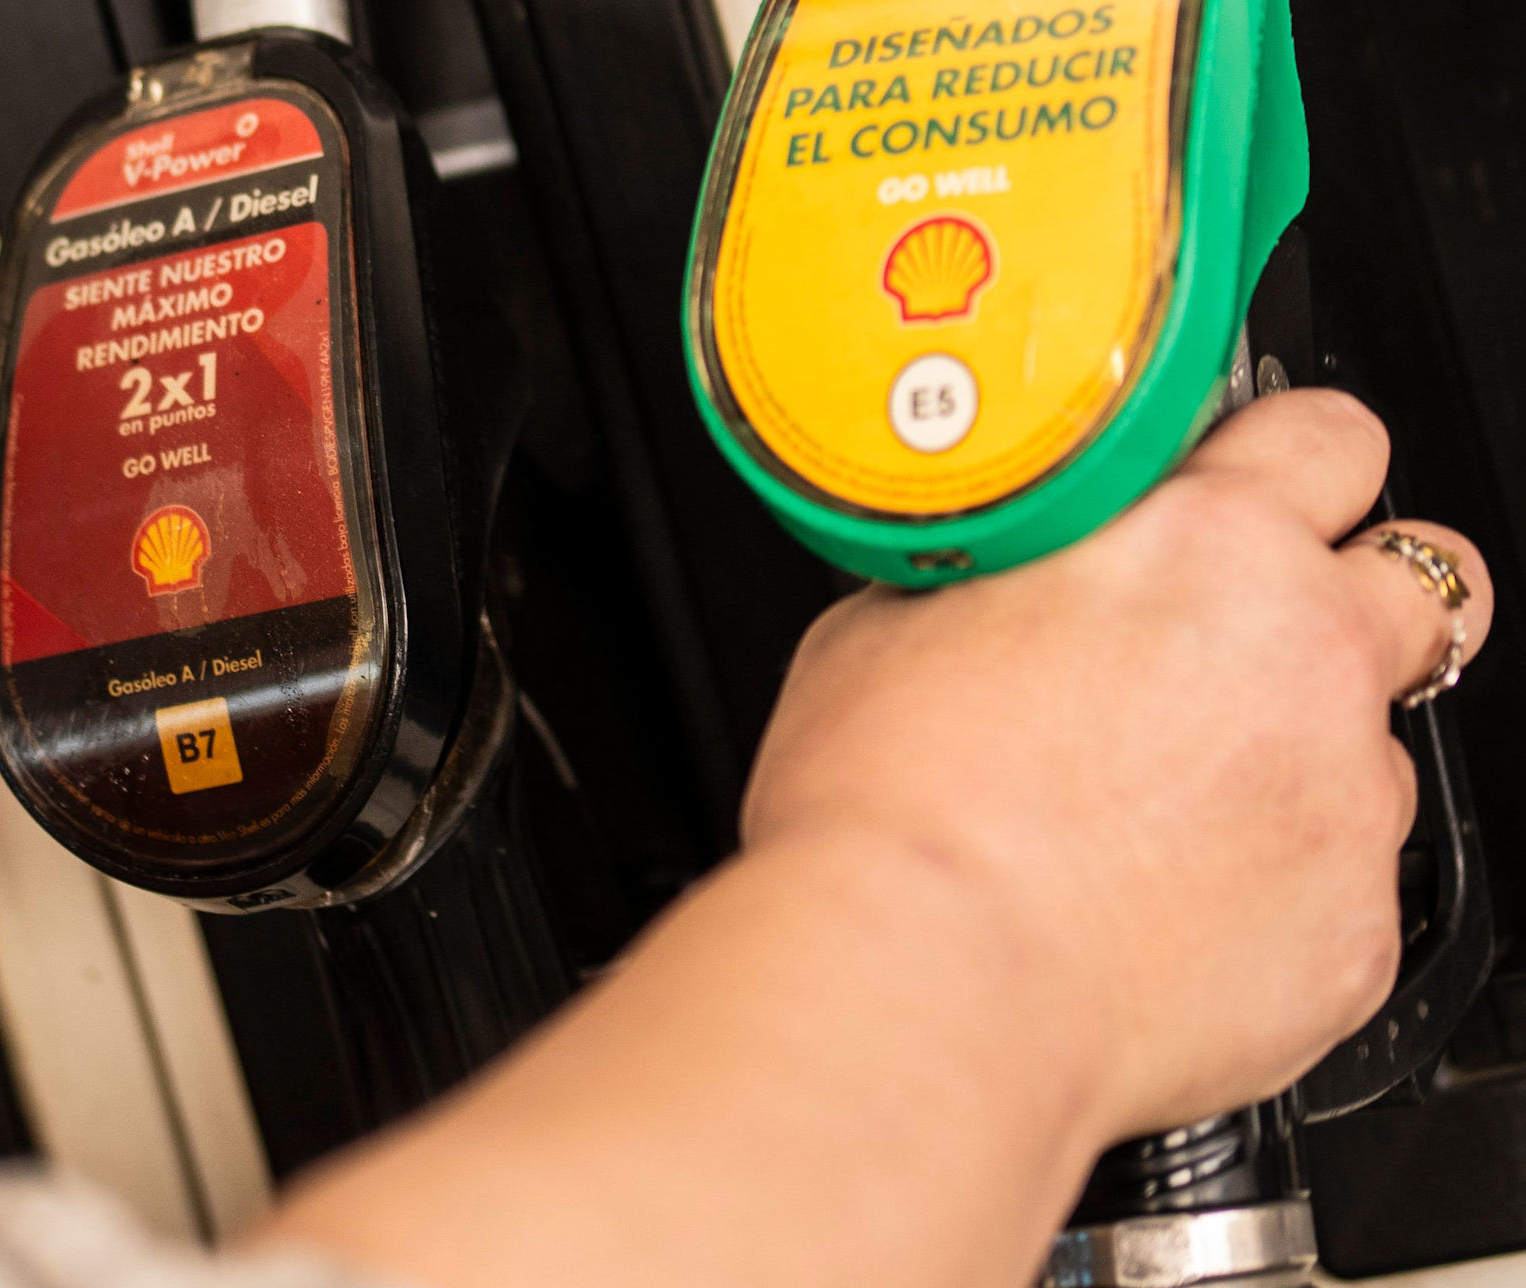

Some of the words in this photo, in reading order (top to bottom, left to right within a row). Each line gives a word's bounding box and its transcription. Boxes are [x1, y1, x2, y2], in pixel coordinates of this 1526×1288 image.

[828, 5, 1116, 69] DISEÑADOS
[784, 76, 911, 119] PARA
[931, 46, 1137, 101] REDUCIR
[127, 133, 174, 159] Shell
[786, 134, 830, 167] EL
[851, 96, 1117, 160] CONSUMO
[124, 142, 247, 186] V-Power
[878, 175, 928, 206] GO
[936, 165, 1010, 198] WELL
[46, 218, 165, 268] Gasóleo
[173, 207, 196, 237] A
[230, 174, 318, 222] Diesel
[64, 270, 152, 311] SIENTE
[160, 238, 286, 290] NUESTRO
[110, 283, 233, 331] MÁXIMO
[76, 308, 264, 371] RENDIMIENTO
[120, 352, 217, 420] 2x1
[911, 386, 956, 421] E5
[119, 418, 143, 437] en
[150, 402, 216, 434] puntos
[123, 455, 156, 479] GO
[160, 443, 212, 472] WELL
[108, 669, 177, 698] Gasóleo
[181, 664, 196, 682] A
[213, 649, 263, 677] Diesel
[176, 729, 216, 763] B7
